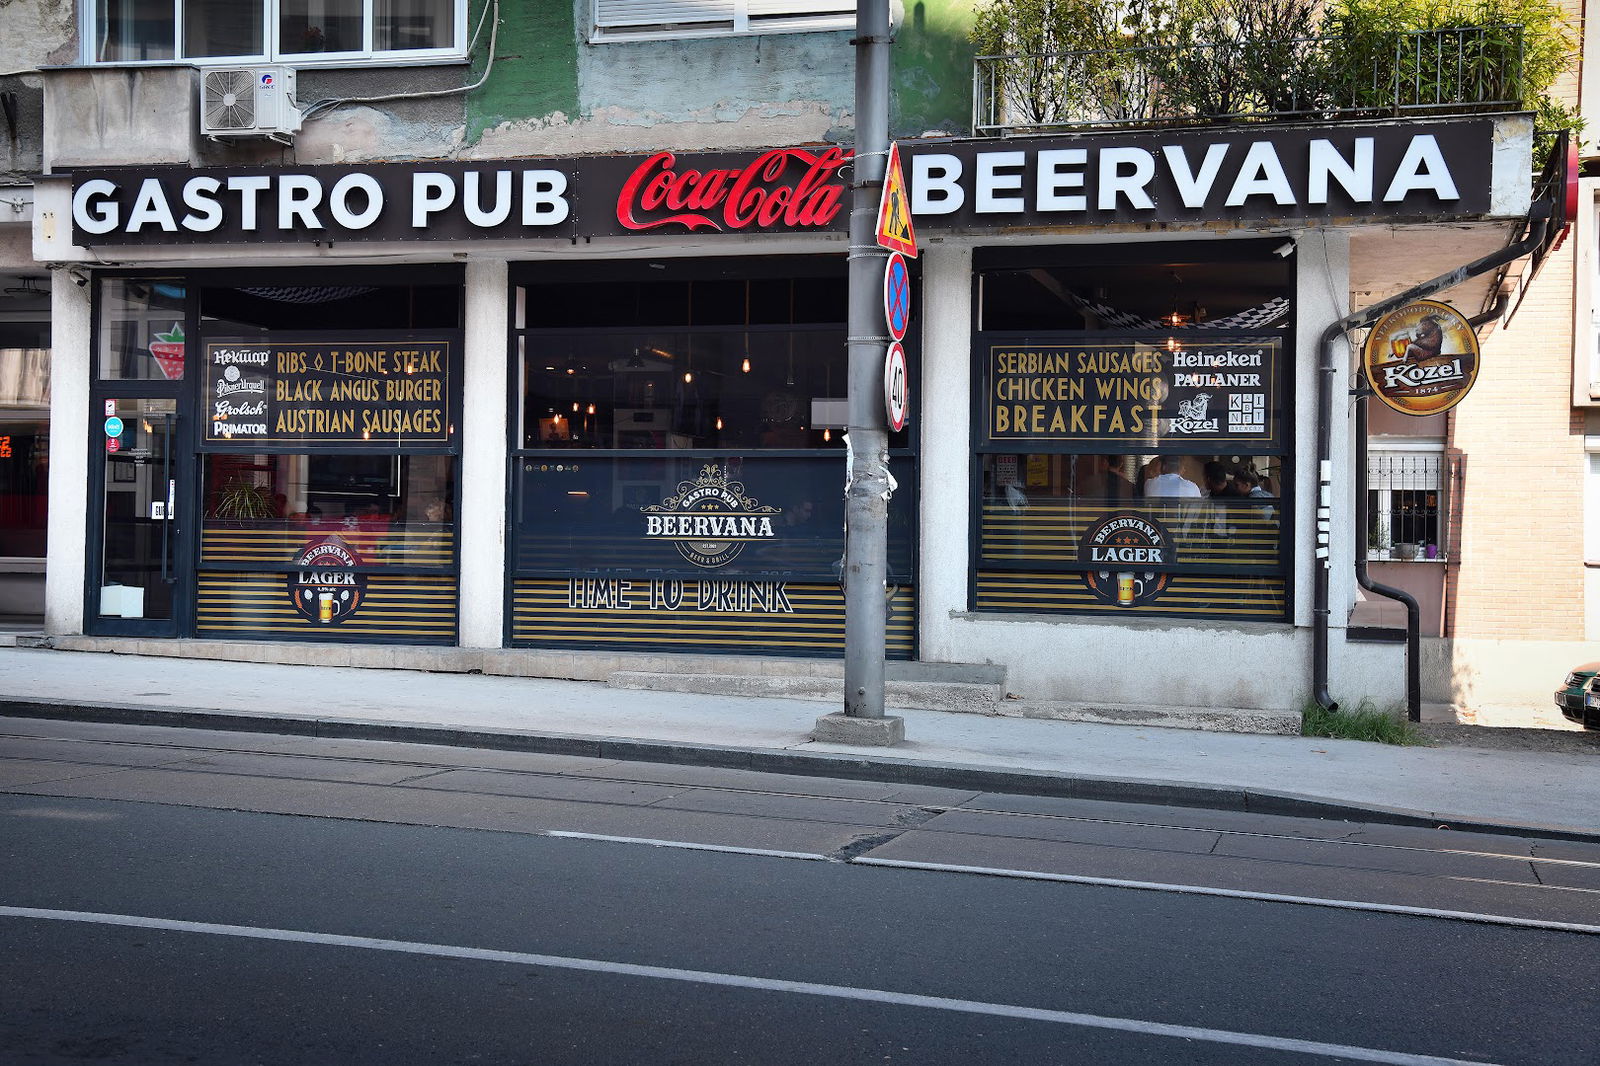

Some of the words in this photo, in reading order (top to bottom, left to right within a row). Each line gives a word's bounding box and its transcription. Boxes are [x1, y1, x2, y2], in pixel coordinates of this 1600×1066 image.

[912, 134, 1461, 215] BEERVANA
[616, 147, 854, 231] Coca-Cola
[72, 173, 384, 234] GASTRO
[412, 169, 570, 228] PUB
[277, 352, 307, 374] RIBS
[331, 351, 386, 373] T-BONE
[393, 350, 442, 373] STEAK
[998, 352, 1069, 374] SERBIAN
[1077, 352, 1163, 373] SAUSAGES
[1173, 350, 1263, 367] Heineken
[1174, 373, 1261, 387] PAULANER
[1383, 358, 1464, 389] Kozel
[276, 379, 323, 402] BLACK
[330, 380, 380, 402] ANGUS
[386, 379, 441, 401] BURGER
[891, 366, 903, 410] 40
[997, 377, 1085, 401] CHICKEN
[1095, 377, 1163, 401] WINGS
[1415, 386, 1439, 395] 1874
[214, 400, 266, 420] Grolsch
[275, 409, 355, 433] AUSTRIAN
[362, 409, 442, 433] SAUSAGES
[996, 405, 1162, 433] BREAKFAST
[214, 421, 268, 436] PRIMATOR
[1169, 417, 1220, 434] Kozel
[682, 488, 720, 508] GASTRO
[720, 490, 739, 509] PUB
[646, 516, 775, 537] BEERVANA
[1094, 518, 1161, 546] BEERVANA
[301, 545, 355, 567] BEERVANA
[1091, 547, 1162, 563] LAGER
[298, 571, 356, 585] LAGER
[568, 577, 632, 609] TIME
[650, 577, 685, 611] TO
[697, 578, 794, 613] DRINK
